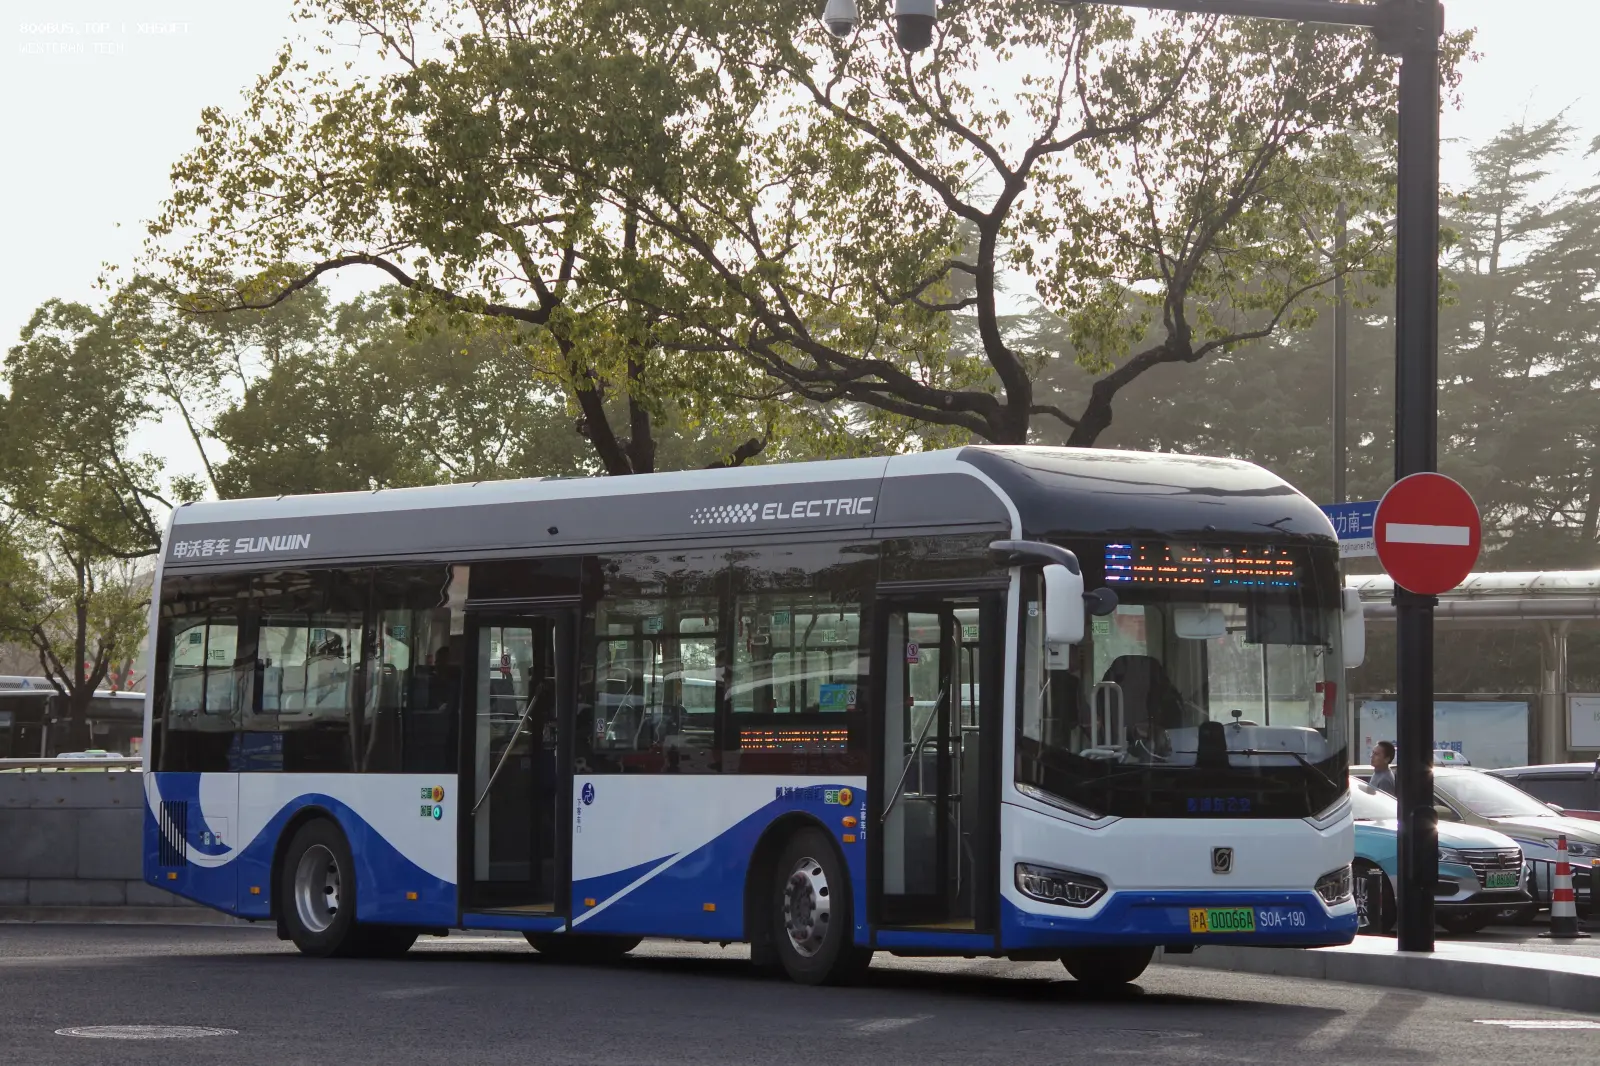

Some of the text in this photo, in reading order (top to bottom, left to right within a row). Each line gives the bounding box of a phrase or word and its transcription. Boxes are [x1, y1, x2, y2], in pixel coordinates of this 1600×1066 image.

[762, 497, 874, 520] ELECTRIC
[173, 534, 311, 558] 申沃客车 SUNWIN
